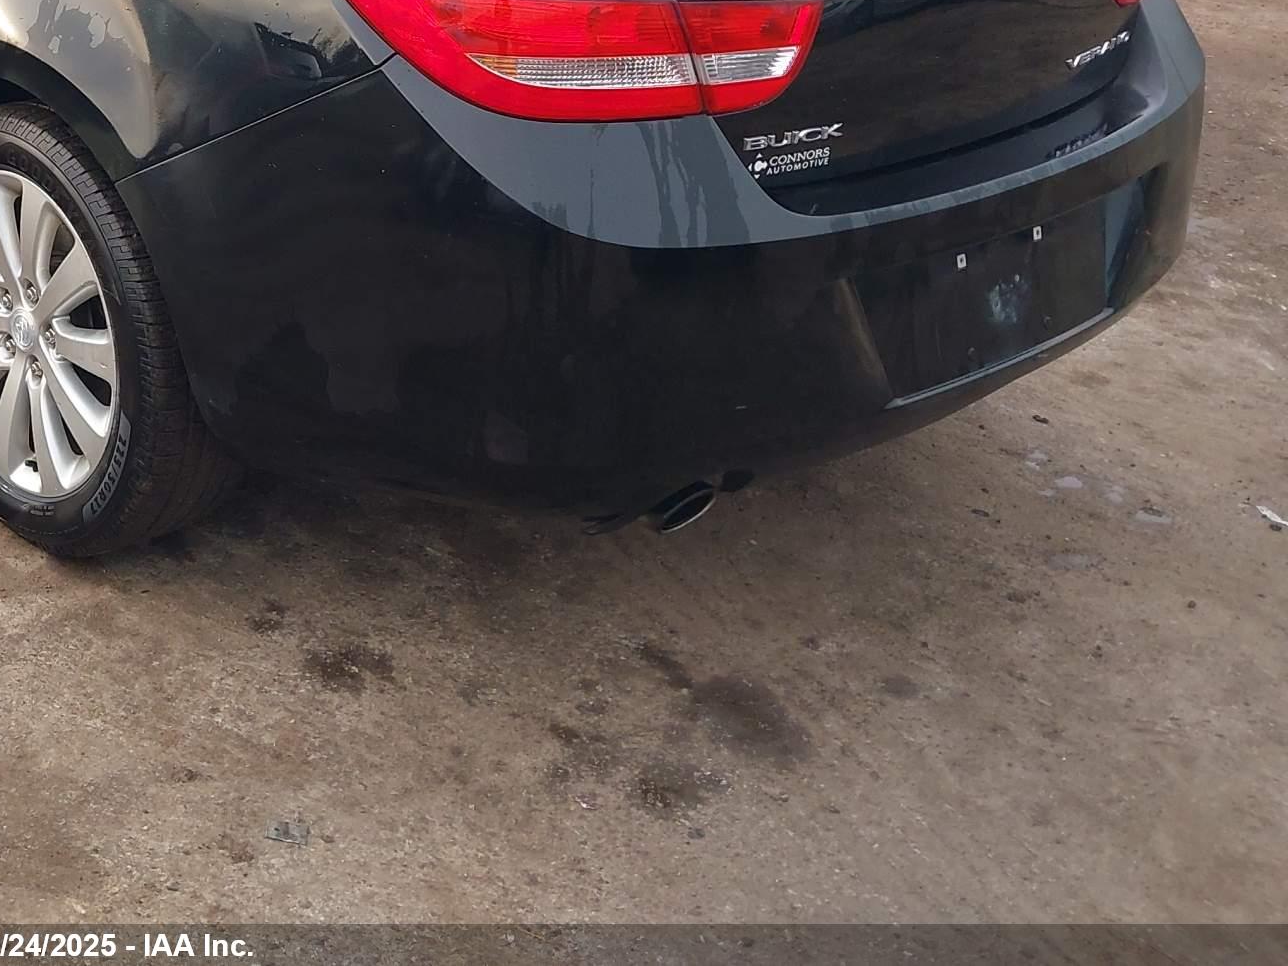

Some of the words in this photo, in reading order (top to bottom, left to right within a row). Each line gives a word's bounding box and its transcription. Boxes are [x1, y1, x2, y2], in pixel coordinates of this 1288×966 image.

[743, 122, 844, 152] BUICK
[766, 157, 830, 176] AUTOMOTIVE
[769, 147, 831, 166] CONNORS
[90, 433, 127, 515] 225/50R17
